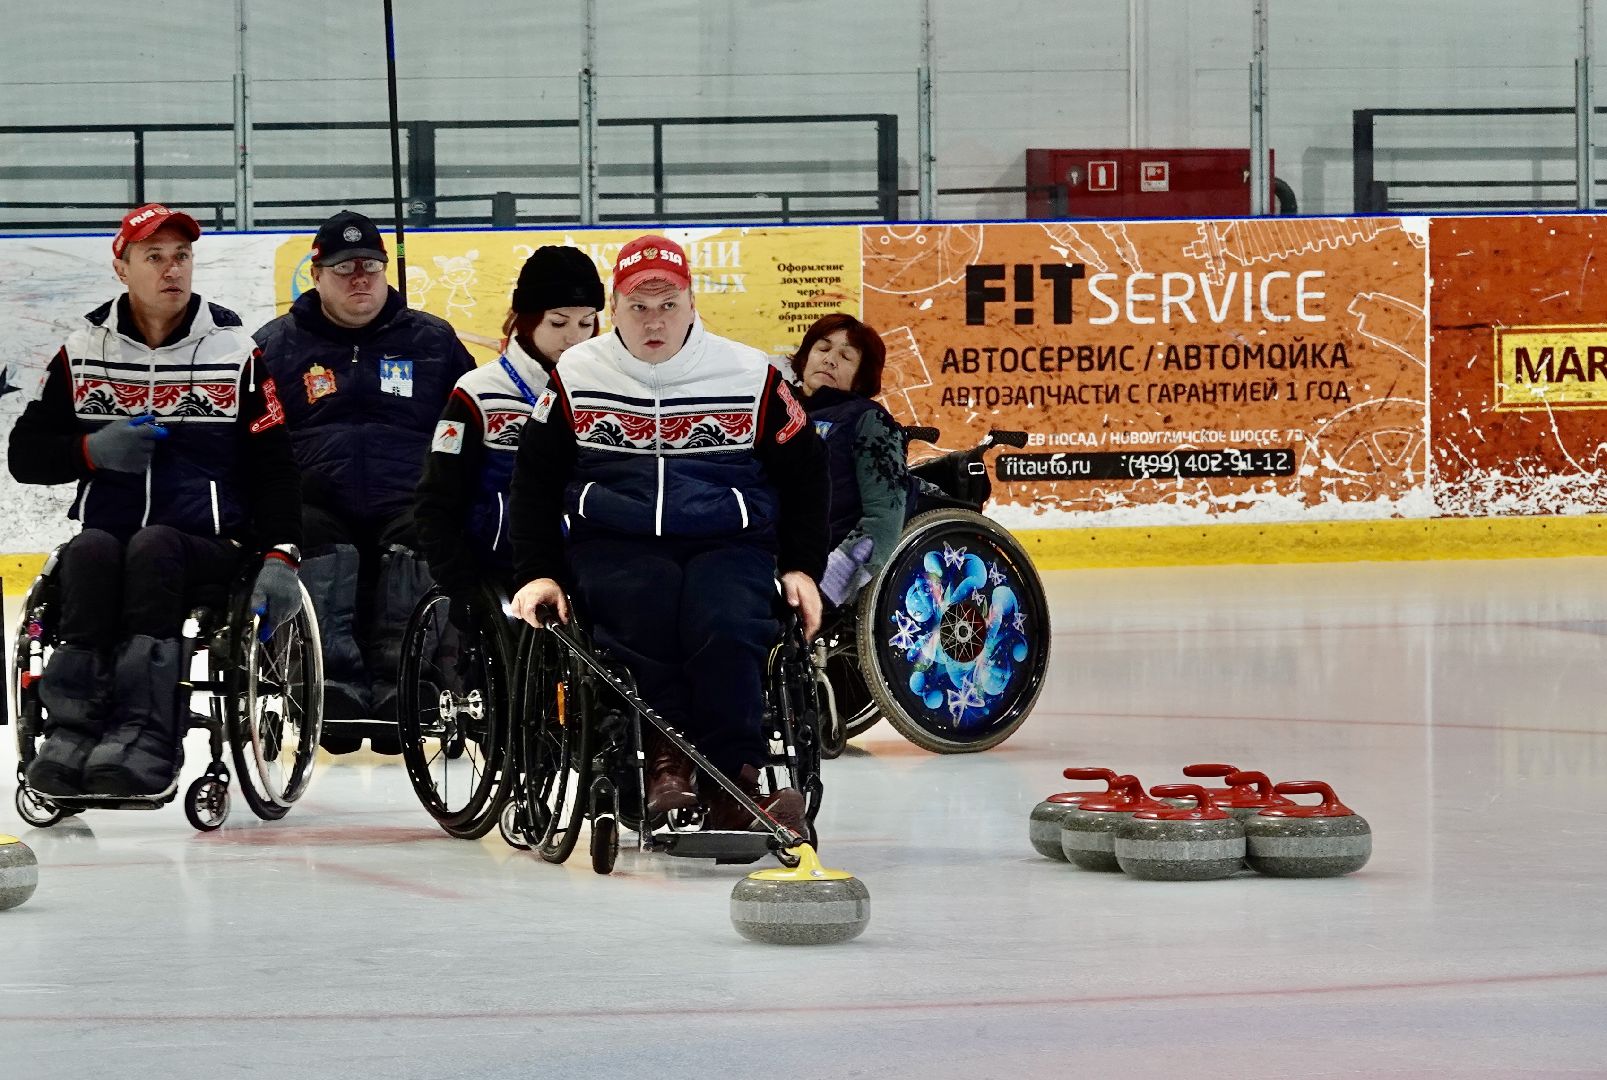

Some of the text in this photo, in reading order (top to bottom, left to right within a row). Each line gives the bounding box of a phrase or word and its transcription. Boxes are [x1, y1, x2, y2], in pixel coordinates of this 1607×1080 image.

[660, 249, 683, 267] SIA
[777, 263, 844, 273] Оформление
[781, 276, 841, 285] документов
[796, 289, 825, 297] через
[1088, 270, 1327, 325] SERVICE
[781, 300, 841, 309] Управление
[940, 336, 1351, 374] АВТОСЕРВИС / АВТОМОЙКА
[940, 377, 1351, 407] АВТОЗАПЧАСТИ С ГАРАНТИЕЙ 1 ГОД
[1048, 432, 1098, 447] ПОСАД
[1109, 429, 1227, 445] НОВОУГЛИЧСКОЕ
[1128, 454, 1180, 477] (499)
[1184, 452, 1288, 472] 402-91-12
